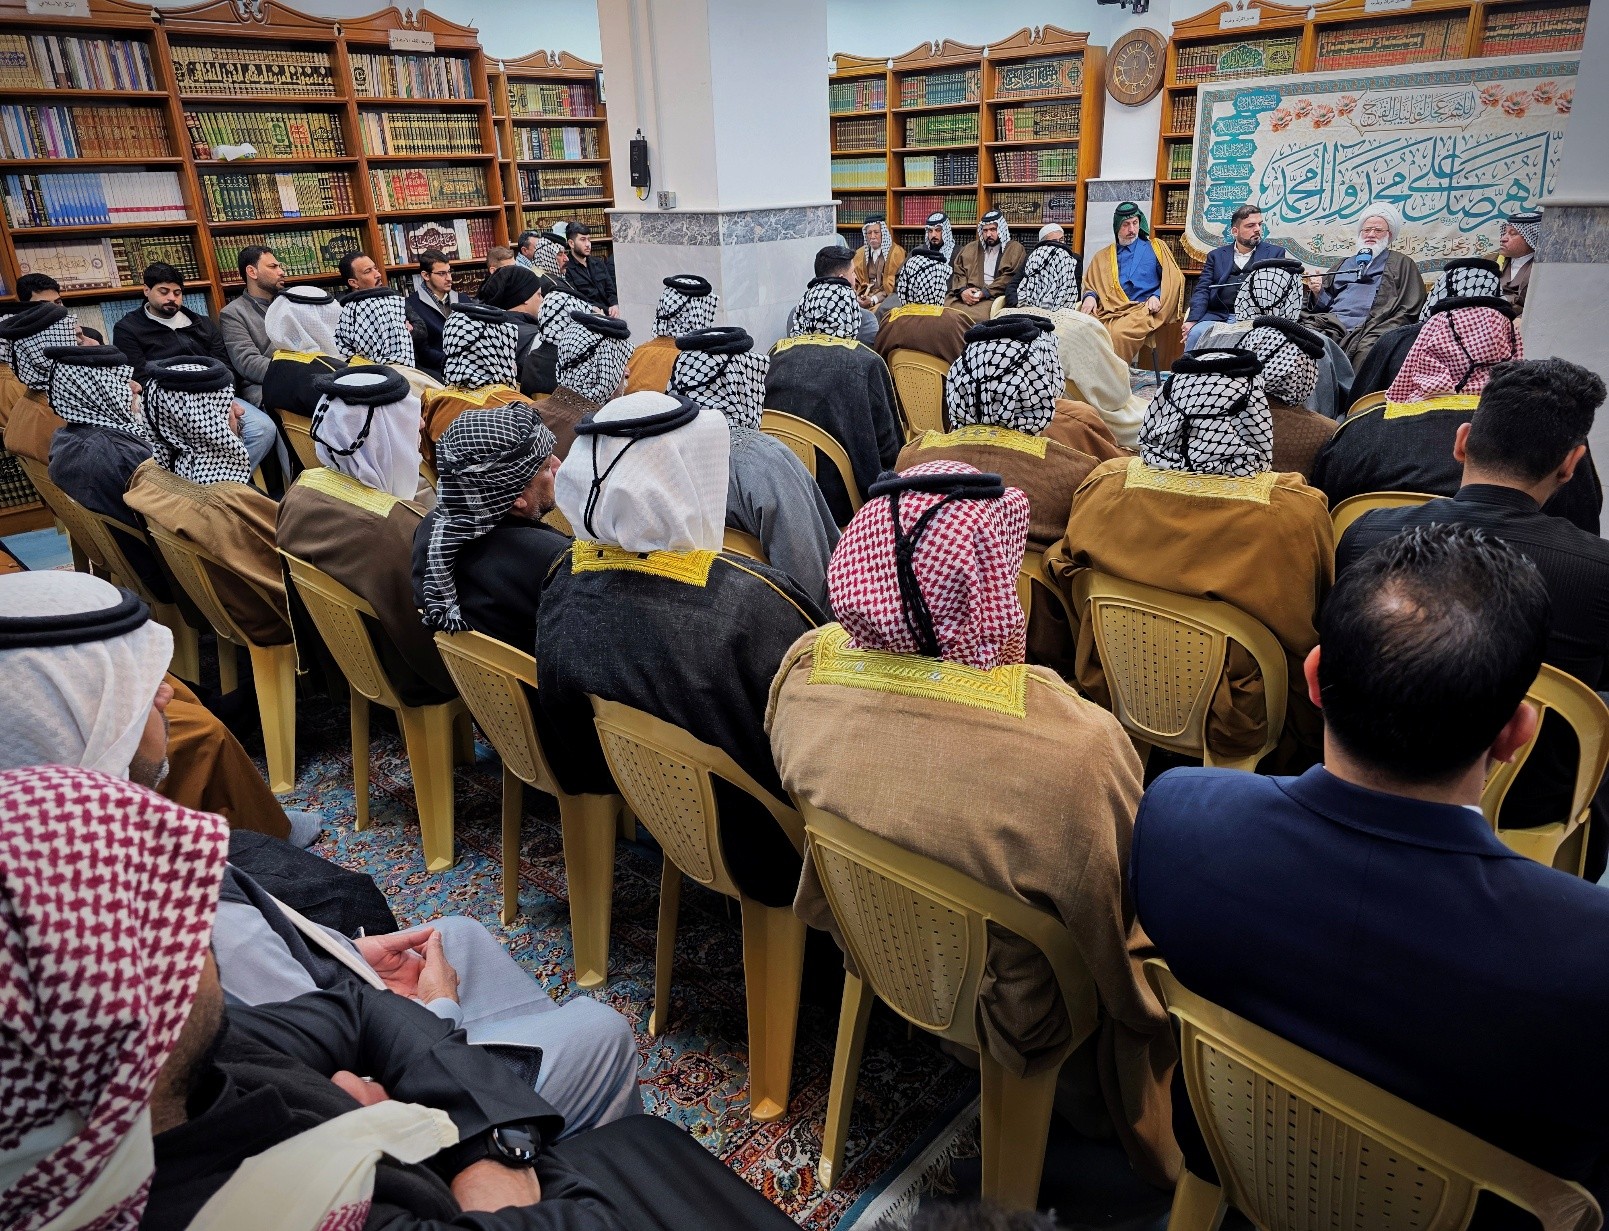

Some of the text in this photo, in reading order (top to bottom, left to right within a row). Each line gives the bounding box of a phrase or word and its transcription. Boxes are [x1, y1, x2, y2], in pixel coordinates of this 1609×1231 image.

[1039, 67, 1057, 84] فقه
[1360, 96, 1397, 127] الفرج
[1438, 90, 1476, 123] اللهم
[1257, 149, 1326, 215] محمد
[1416, 238, 1447, 257] فرجهم
[1442, 236, 1471, 257] وعجل
